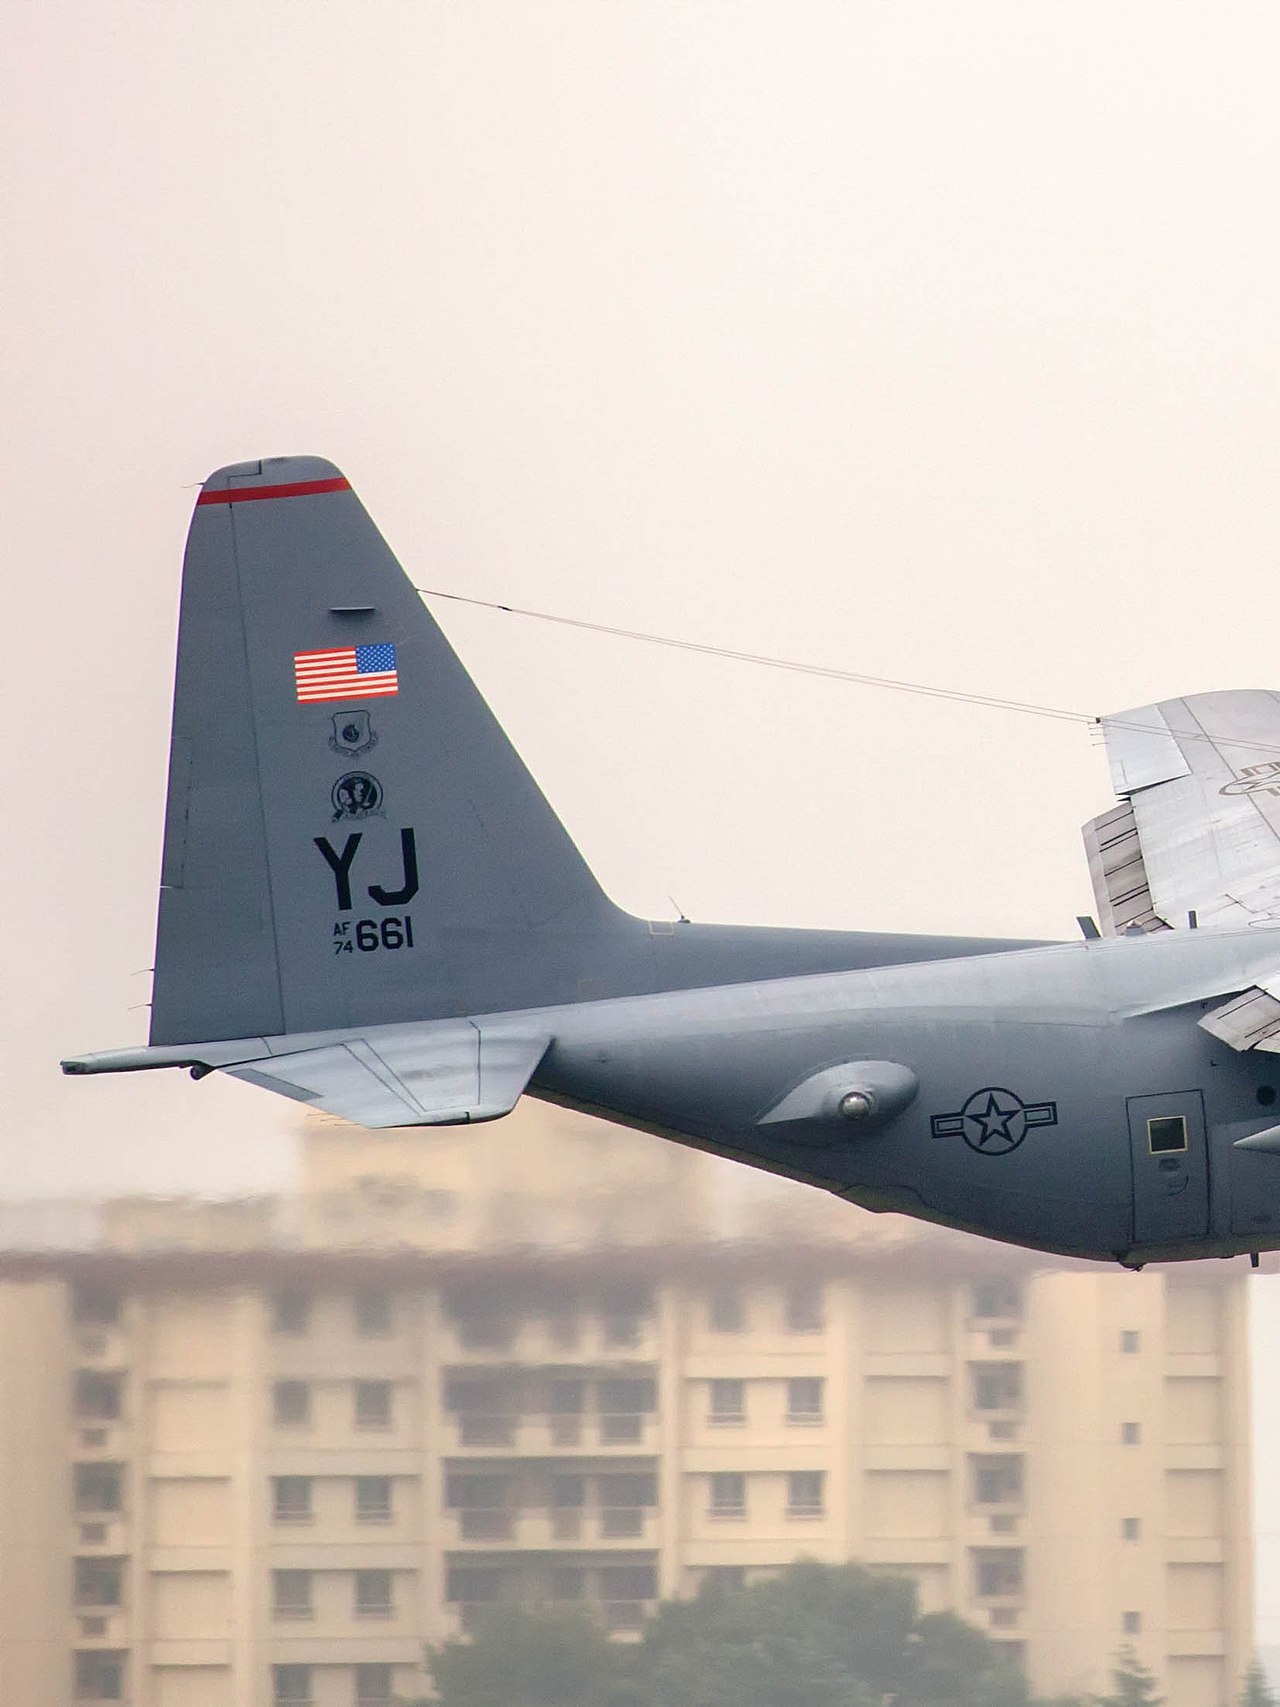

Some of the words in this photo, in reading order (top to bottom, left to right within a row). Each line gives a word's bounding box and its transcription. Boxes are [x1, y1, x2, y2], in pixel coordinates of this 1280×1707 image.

[313, 827, 419, 911] YJ
[333, 921, 351, 936] AF
[356, 915, 414, 952] 661
[333, 940, 353, 955] 74
